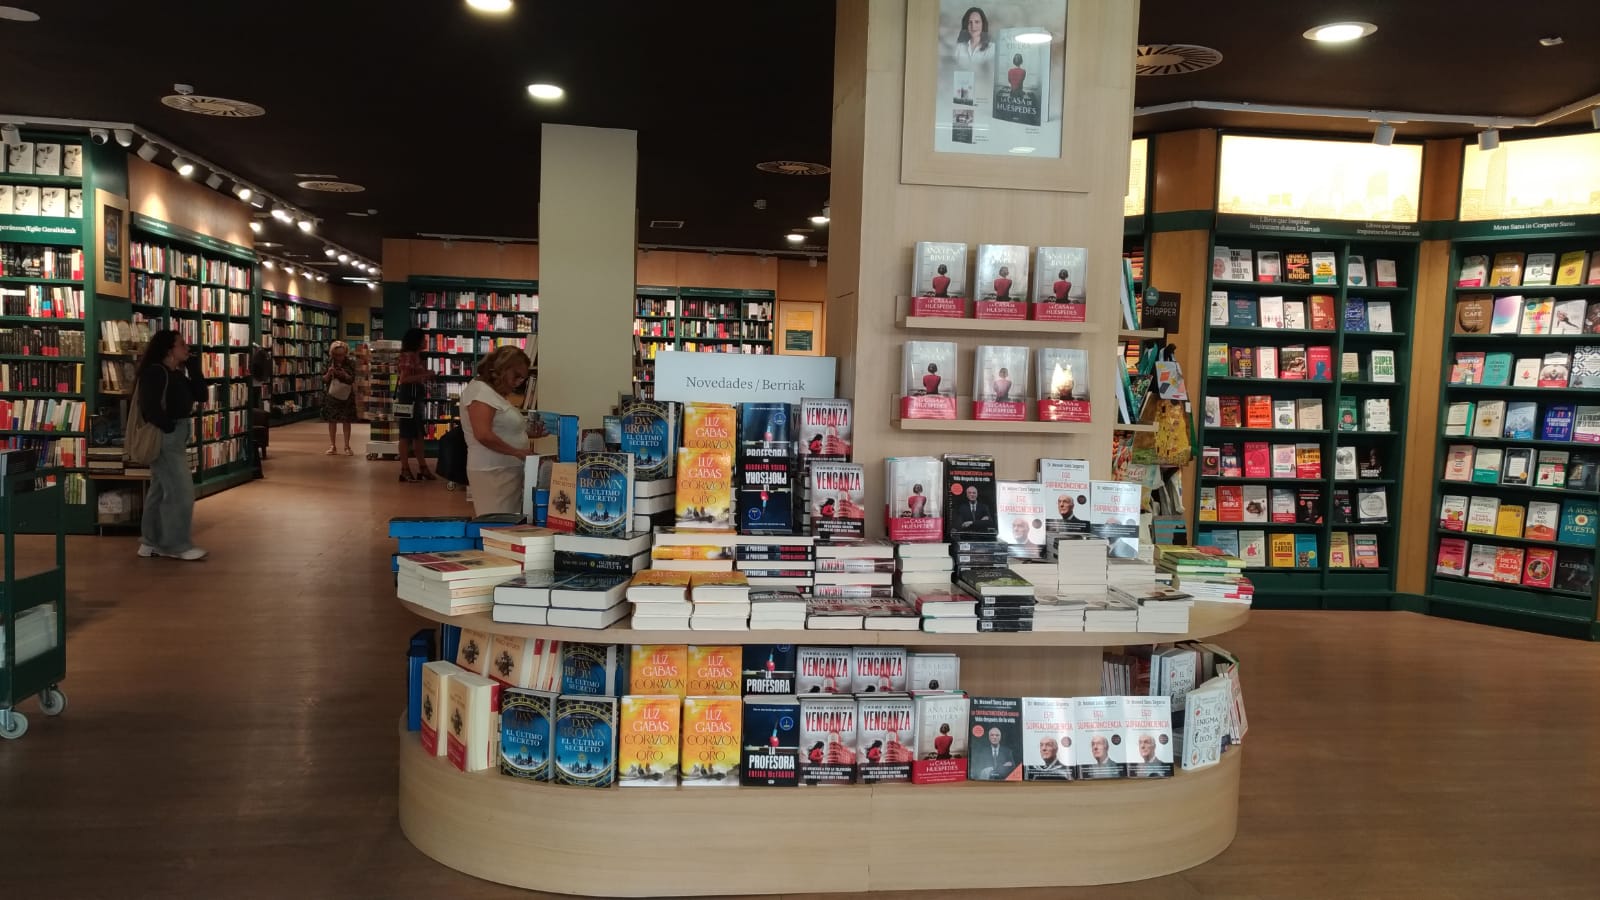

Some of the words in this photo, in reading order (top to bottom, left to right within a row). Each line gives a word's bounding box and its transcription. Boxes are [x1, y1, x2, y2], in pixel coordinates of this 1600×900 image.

[1008, 96, 1026, 105] CASA
[1144, 306, 1176, 316] SHOPPER
[1375, 356, 1392, 365] SUPER
[1375, 366, 1393, 375] SANOS
[686, 376, 752, 390] Novedades
[754, 380, 760, 392] /
[762, 379, 806, 391] Berriak
[634, 416, 653, 425] DAN
[806, 407, 848, 426] VENGANZA
[704, 417, 719, 427] LUZ
[624, 424, 664, 434] BROWN
[698, 456, 713, 467] LUZ
[591, 470, 610, 480] DAN
[745, 472, 787, 484] PROFESORA
[580, 479, 623, 489] BROWN
[816, 472, 860, 490] VENGANZA
[584, 494, 616, 502] SECRETO
[692, 495, 716, 504] ORO
[1565, 525, 1595, 534] PUESTA
[652, 655, 669, 664] LUZ
[708, 656, 724, 665] LUZ
[802, 656, 848, 677] VENGANZA
[857, 656, 902, 677] VENGANZA
[569, 683, 597, 693] SECRETO
[747, 679, 790, 693] PROFESORA
[644, 708, 660, 719] LUZ
[706, 709, 722, 720] LUZ
[572, 719, 594, 728] DAN
[805, 712, 853, 732] VENGANZA
[864, 711, 910, 730] VENGANZA
[1197, 717, 1218, 725] ENIGMA
[561, 728, 607, 739] BROWN
[508, 736, 540, 747] SECRETO
[565, 744, 600, 753] SECRETO
[637, 750, 664, 760] ORO
[699, 750, 725, 761] ORO
[749, 755, 795, 769] PROFESORA
